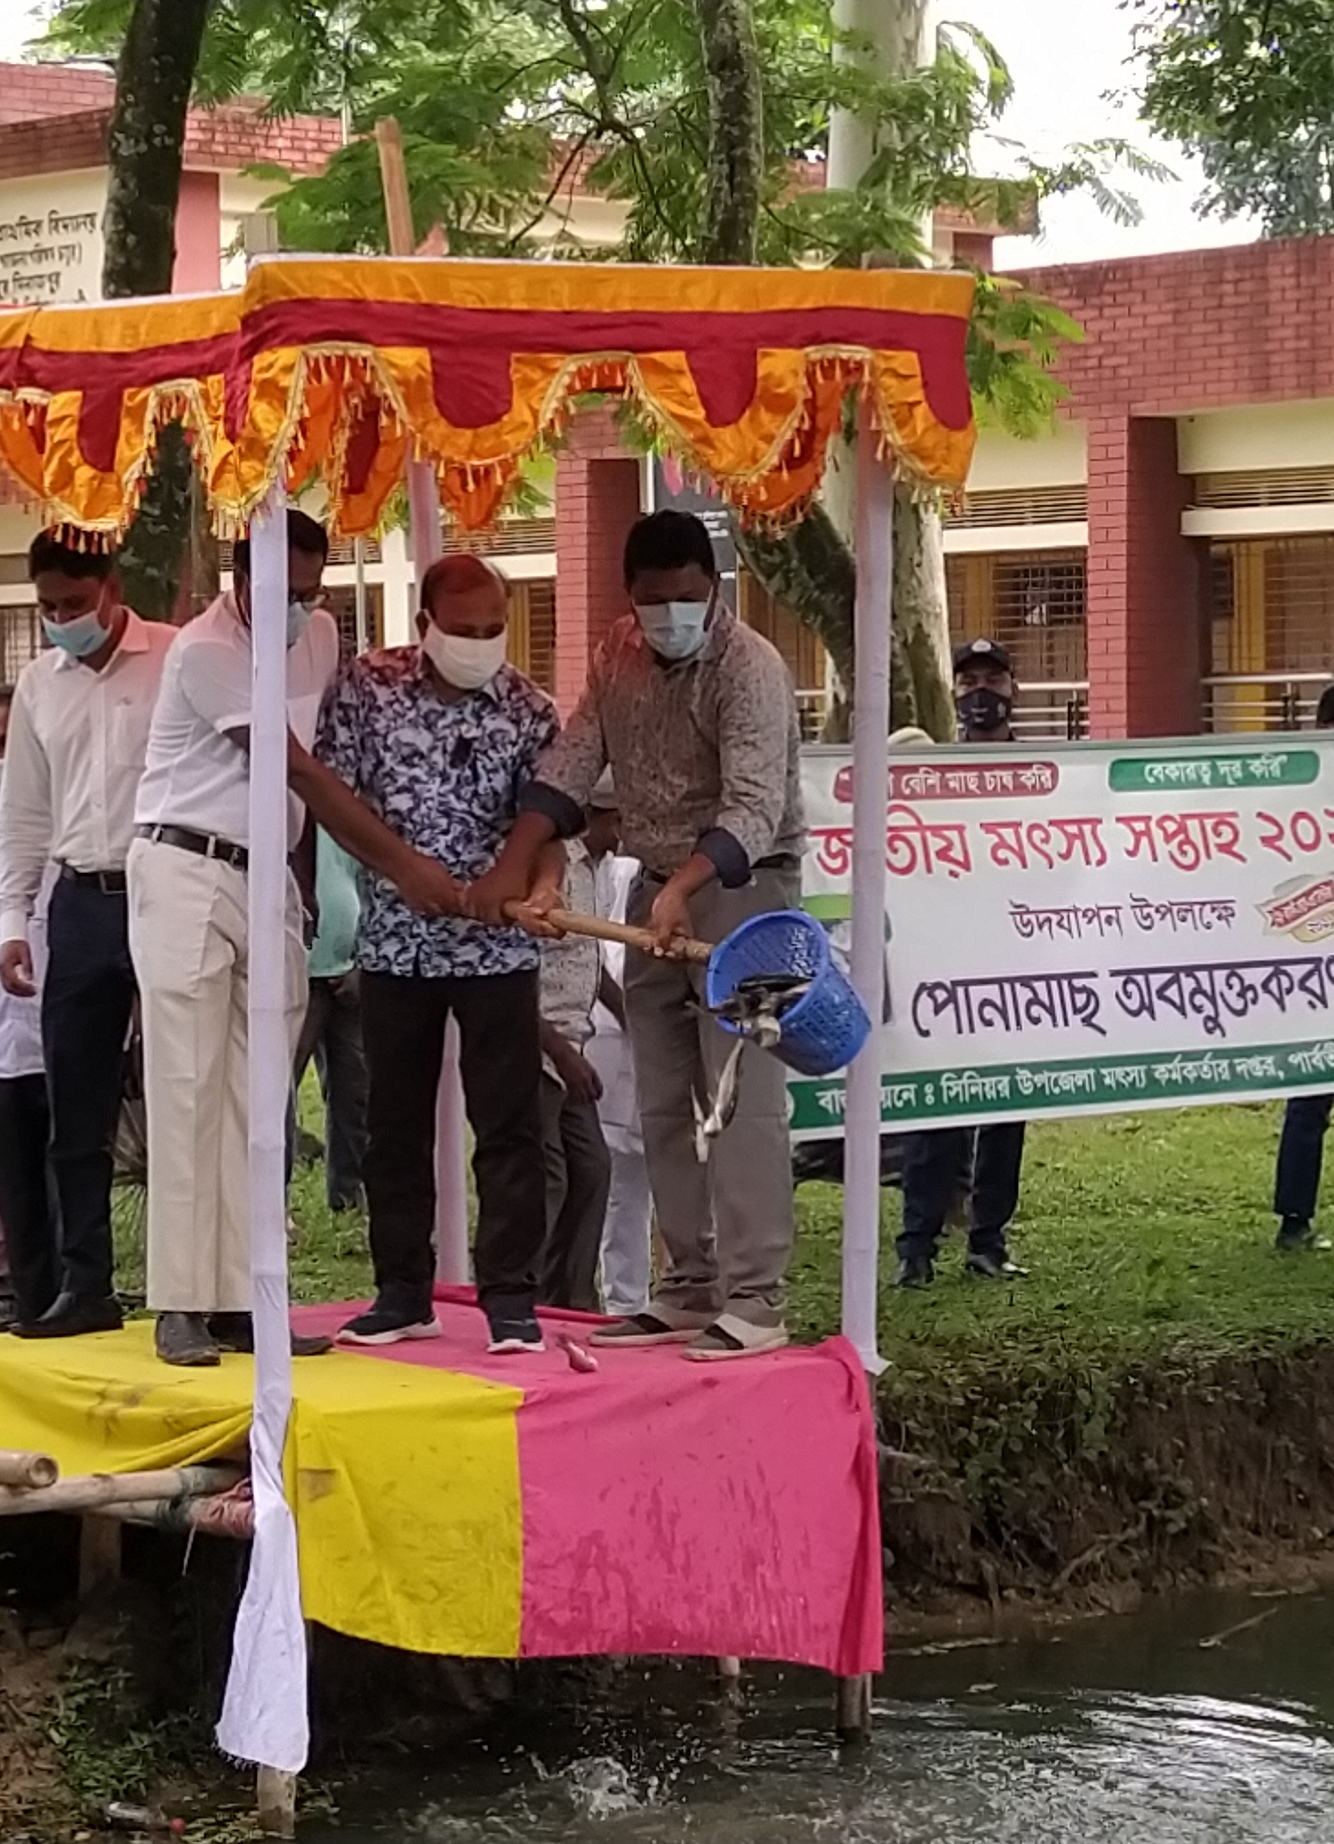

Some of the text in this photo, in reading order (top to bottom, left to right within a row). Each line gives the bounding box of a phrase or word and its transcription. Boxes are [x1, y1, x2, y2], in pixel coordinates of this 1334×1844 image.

[47, 209, 98, 236] বিদ্যালয়
[901, 766, 941, 794] বেশি
[945, 771, 980, 794] মাছ
[982, 769, 1014, 792] চাষ
[1019, 763, 1053, 790] করি
[1143, 760, 1213, 785] বেকারত্ব
[1215, 758, 1243, 786] দূর
[809, 804, 972, 879] জতীয়
[979, 819, 1108, 870] মৎস্য
[1114, 810, 1248, 872] সপ্তাহ
[1009, 899, 1124, 941] উদযাপন
[1129, 892, 1237, 933] উপলক্ষে
[911, 970, 1108, 1038] পোনামাছ
[940, 1071, 1012, 1105] সিনিয়র
[1015, 1065, 1097, 1097] উপজেলা
[1100, 1063, 1148, 1090] মৎস্য
[1150, 1052, 1230, 1087] কর্মকর্তার
[1232, 1054, 1285, 1081] দপ্তর,
